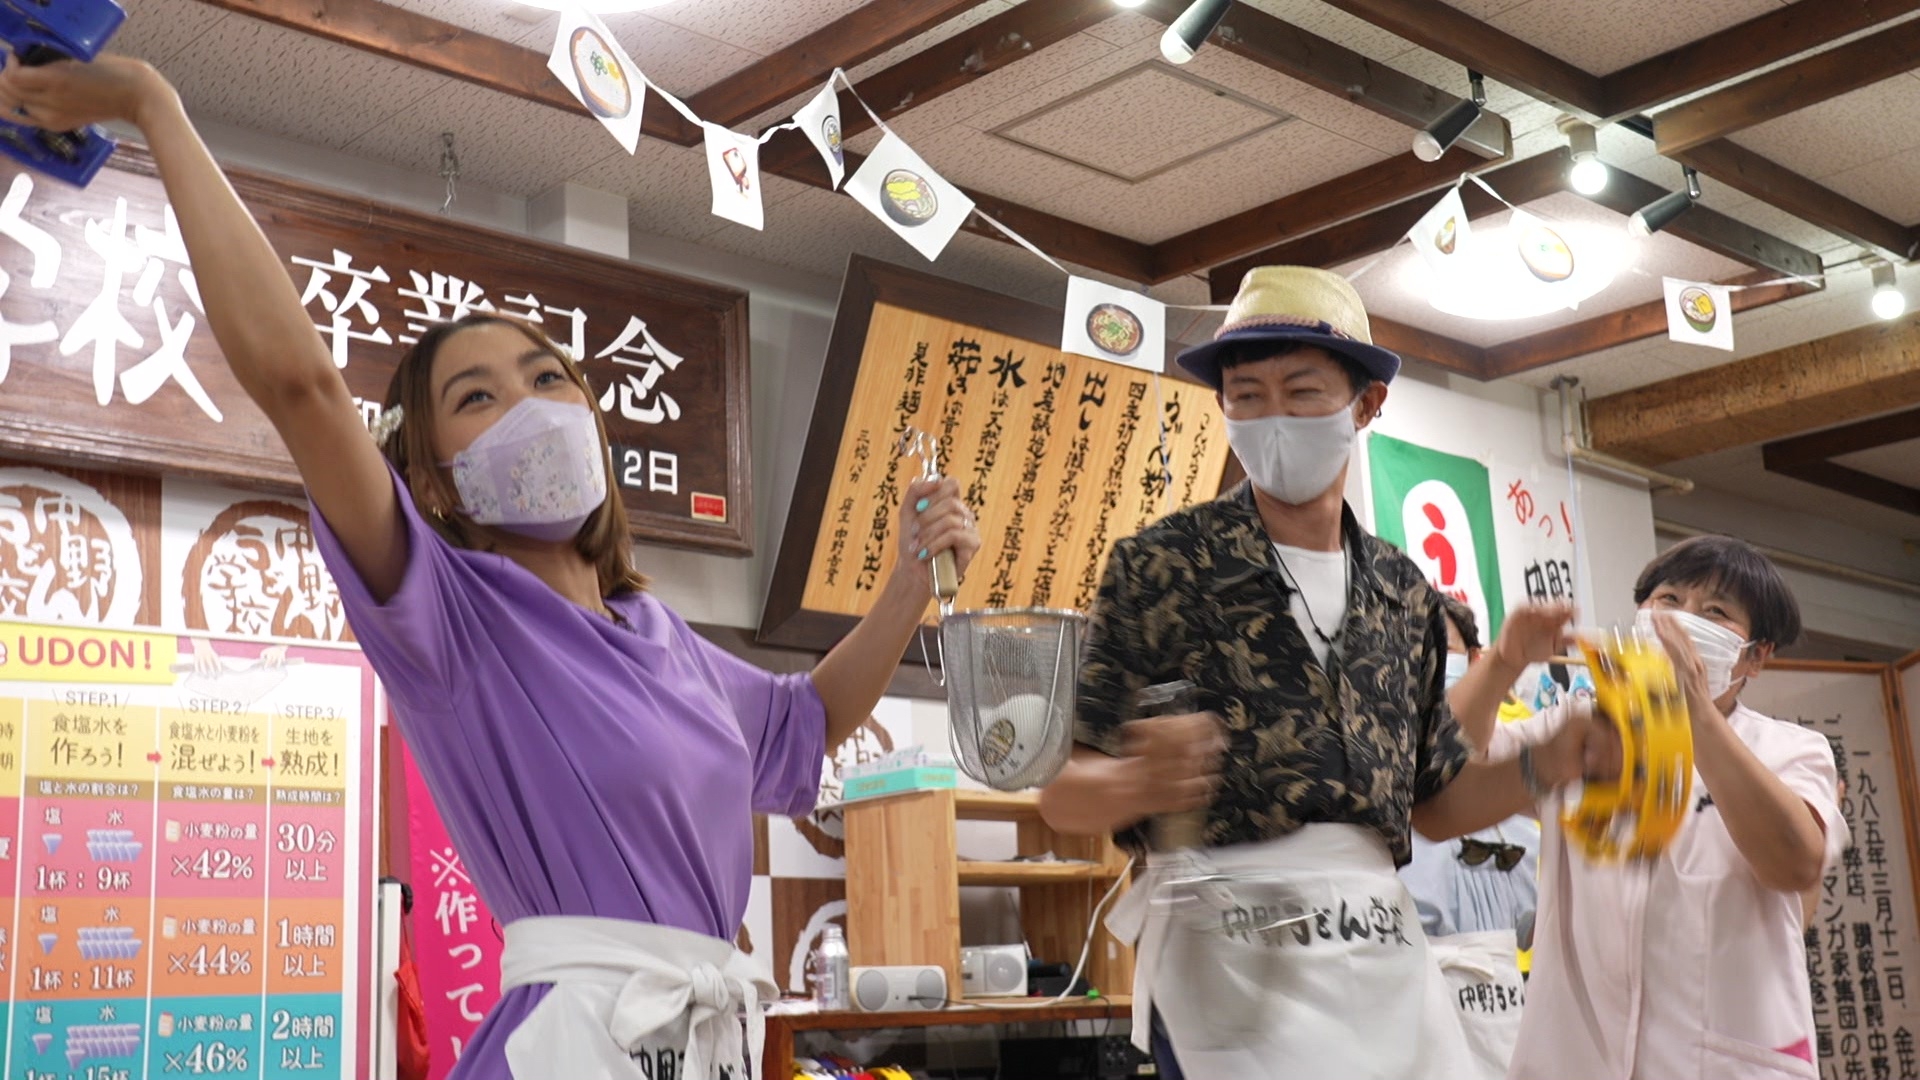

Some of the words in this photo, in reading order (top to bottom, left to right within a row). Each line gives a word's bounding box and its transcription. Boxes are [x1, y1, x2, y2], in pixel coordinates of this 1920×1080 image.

[18, 636, 152, 670] UDON!
[66, 690, 118, 708] STEP.1
[189, 698, 242, 715] STEP.2
[285, 705, 335, 721] STEP.3
[53, 713, 127, 736] 食塩水を
[169, 721, 260, 744] 食塩水と小麦粉を
[286, 727, 333, 747] 生地を
[45, 807, 61, 825] 塩
[108, 809, 124, 826] 水
[184, 823, 258, 840] 小麦粉の量
[277, 823, 337, 853] 30分
[285, 859, 328, 882] 以上
[41, 905, 57, 923] 塩
[103, 906, 120, 923] 水
[182, 918, 256, 935] 小麦粉の量
[276, 918, 335, 948] 1時間
[283, 954, 326, 977] 以上
[36, 1006, 53, 1024] 塩
[99, 1005, 116, 1022] 水
[177, 1013, 253, 1033] 小麦粉の量
[272, 1010, 334, 1040] 2時間
[280, 1046, 324, 1069] 以上
